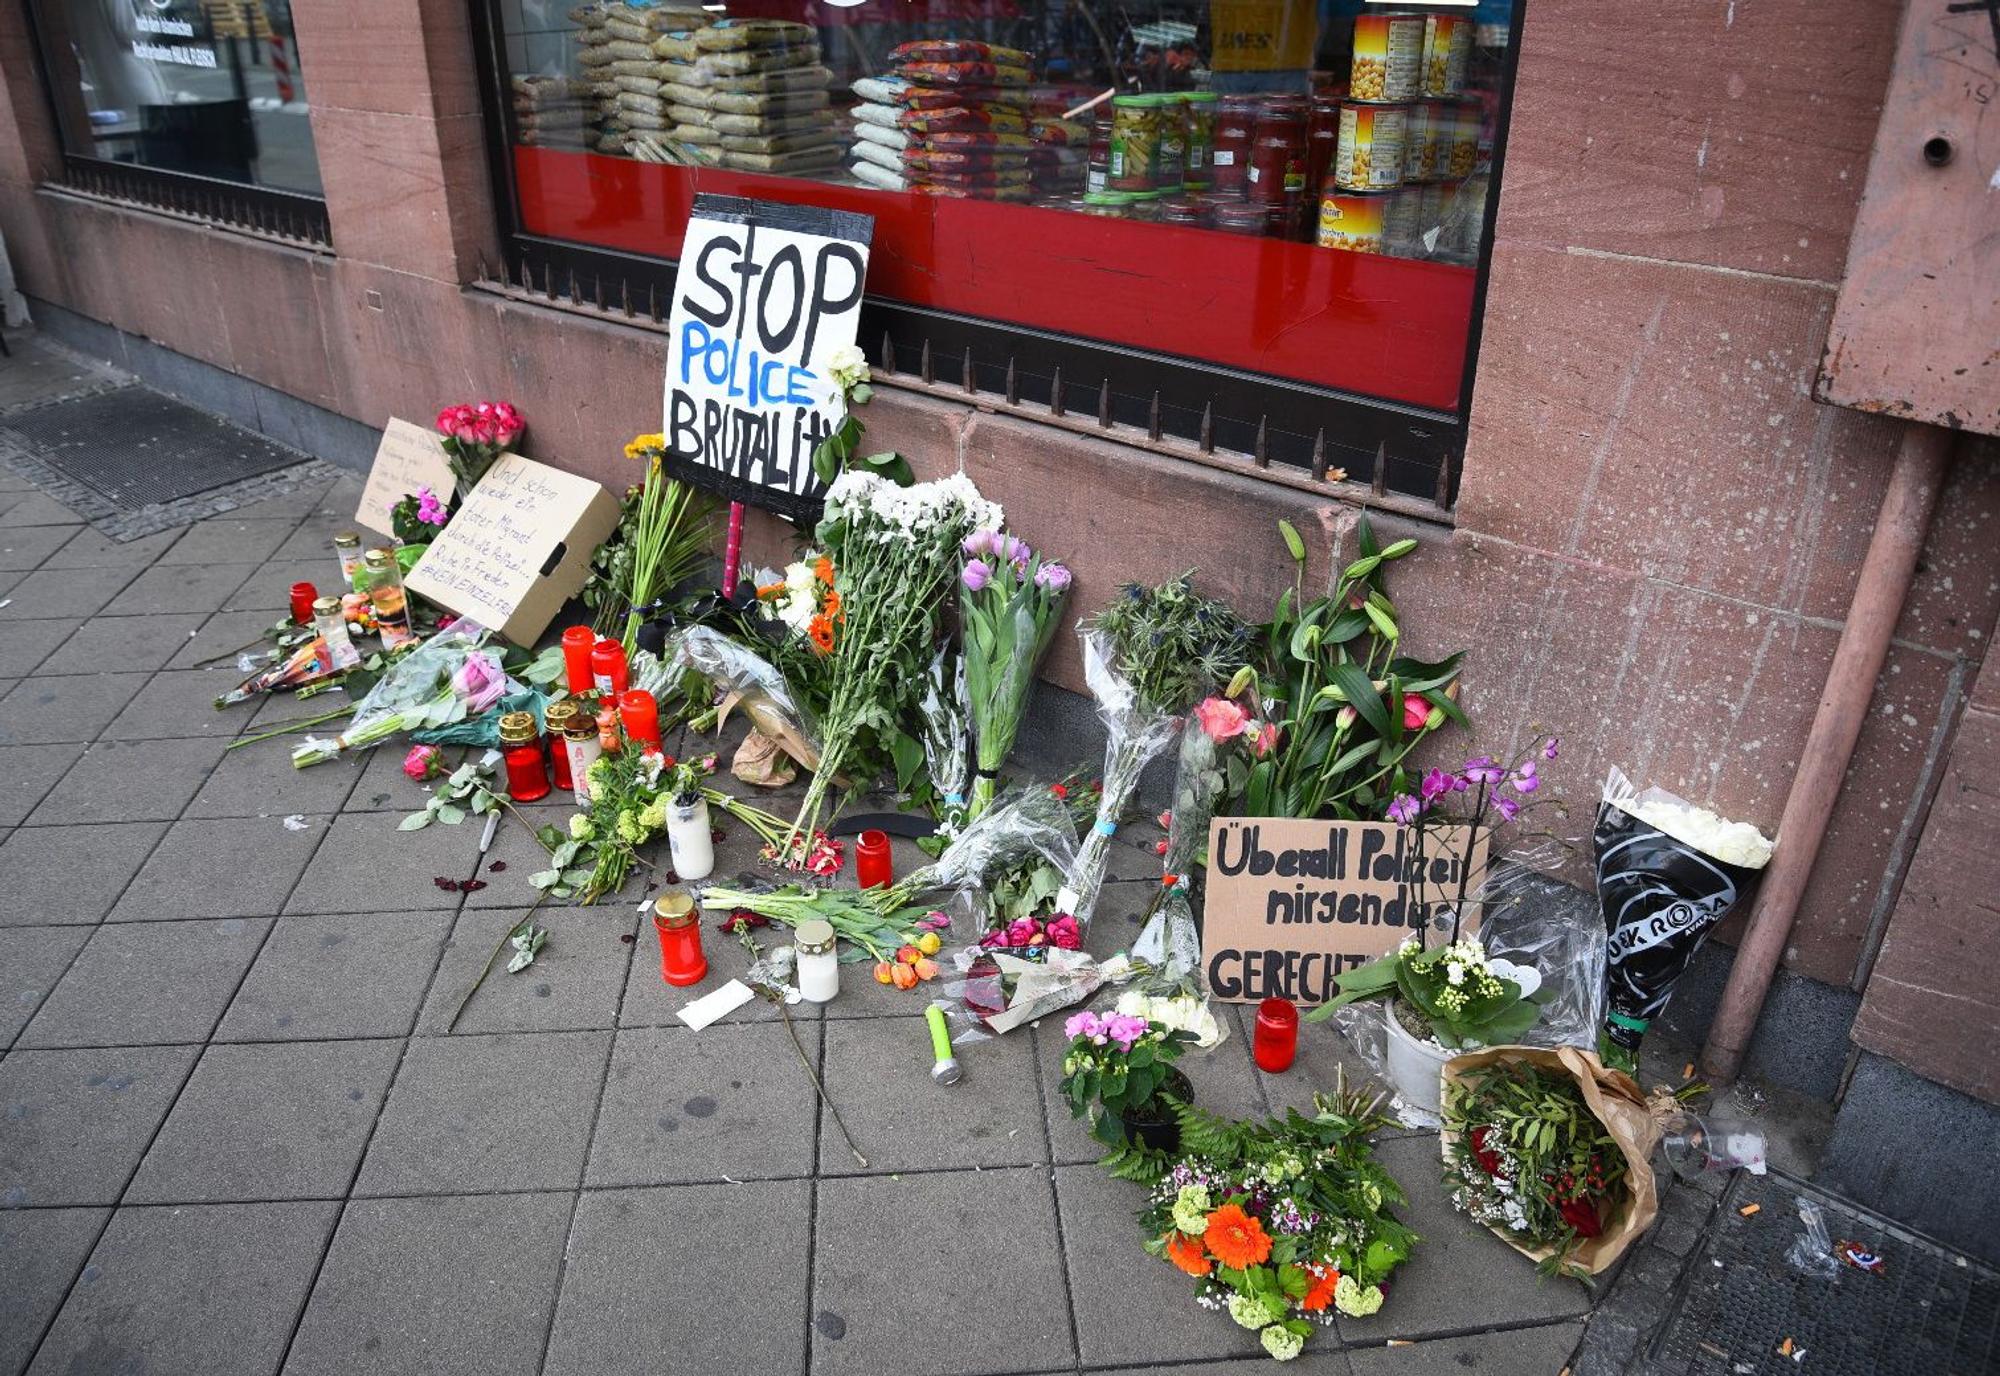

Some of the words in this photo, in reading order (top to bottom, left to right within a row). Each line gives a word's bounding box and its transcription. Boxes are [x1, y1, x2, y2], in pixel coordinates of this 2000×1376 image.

[681, 320, 818, 407] POLICE
[492, 456, 527, 485] Und
[1216, 821, 1349, 881] Überall
[1358, 828, 1460, 884] Polizei
